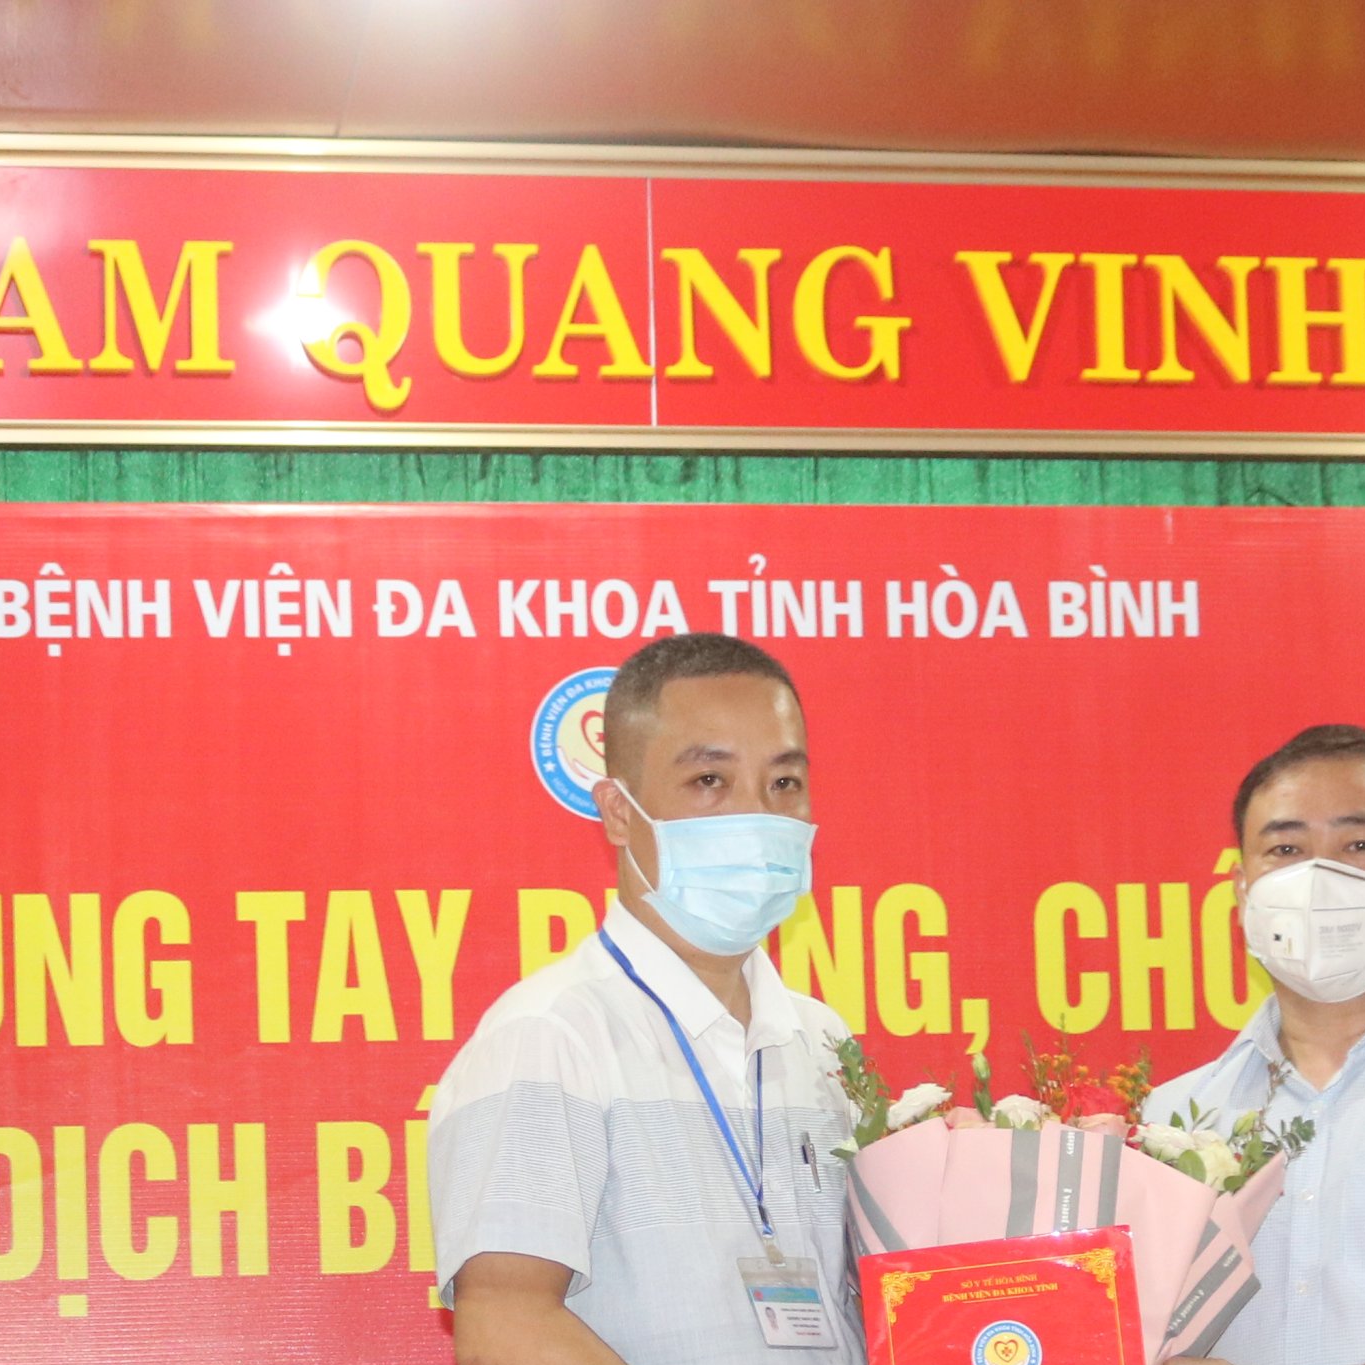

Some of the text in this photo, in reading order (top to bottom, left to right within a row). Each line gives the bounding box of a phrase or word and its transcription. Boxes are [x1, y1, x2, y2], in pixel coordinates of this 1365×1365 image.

[297, 239, 912, 411] QUANG
[192, 561, 354, 657] VIỆN
[371, 578, 478, 638] ĐA
[498, 578, 688, 639] KHOA
[707, 553, 852, 638] TỈNH
[885, 564, 1029, 639] HÒA
[1048, 564, 1200, 638] BÌNH
[235, 888, 472, 1044] TAY
